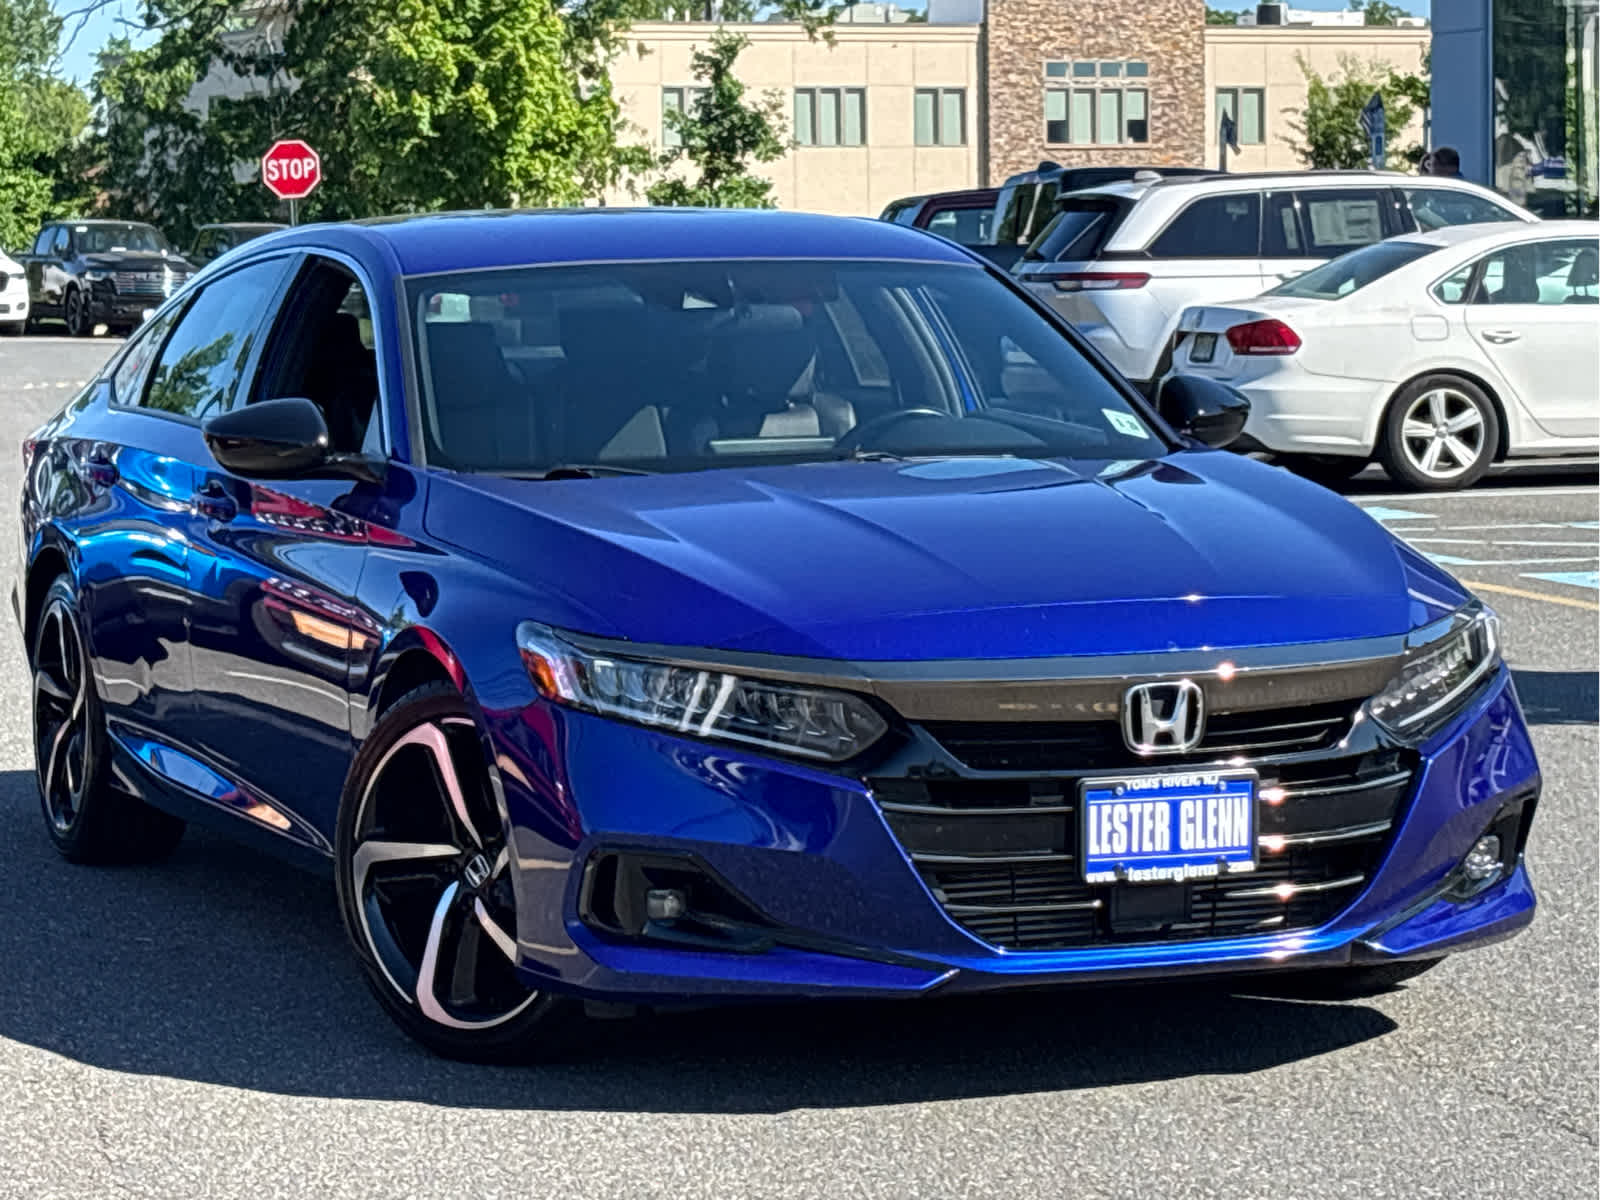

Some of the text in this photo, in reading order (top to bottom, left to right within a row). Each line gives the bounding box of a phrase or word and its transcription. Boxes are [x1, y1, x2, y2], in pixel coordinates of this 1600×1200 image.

[267, 158, 315, 181] STOP
[1125, 777, 1160, 791] TOMS
[1088, 797, 1249, 855] LESTER GLENN
